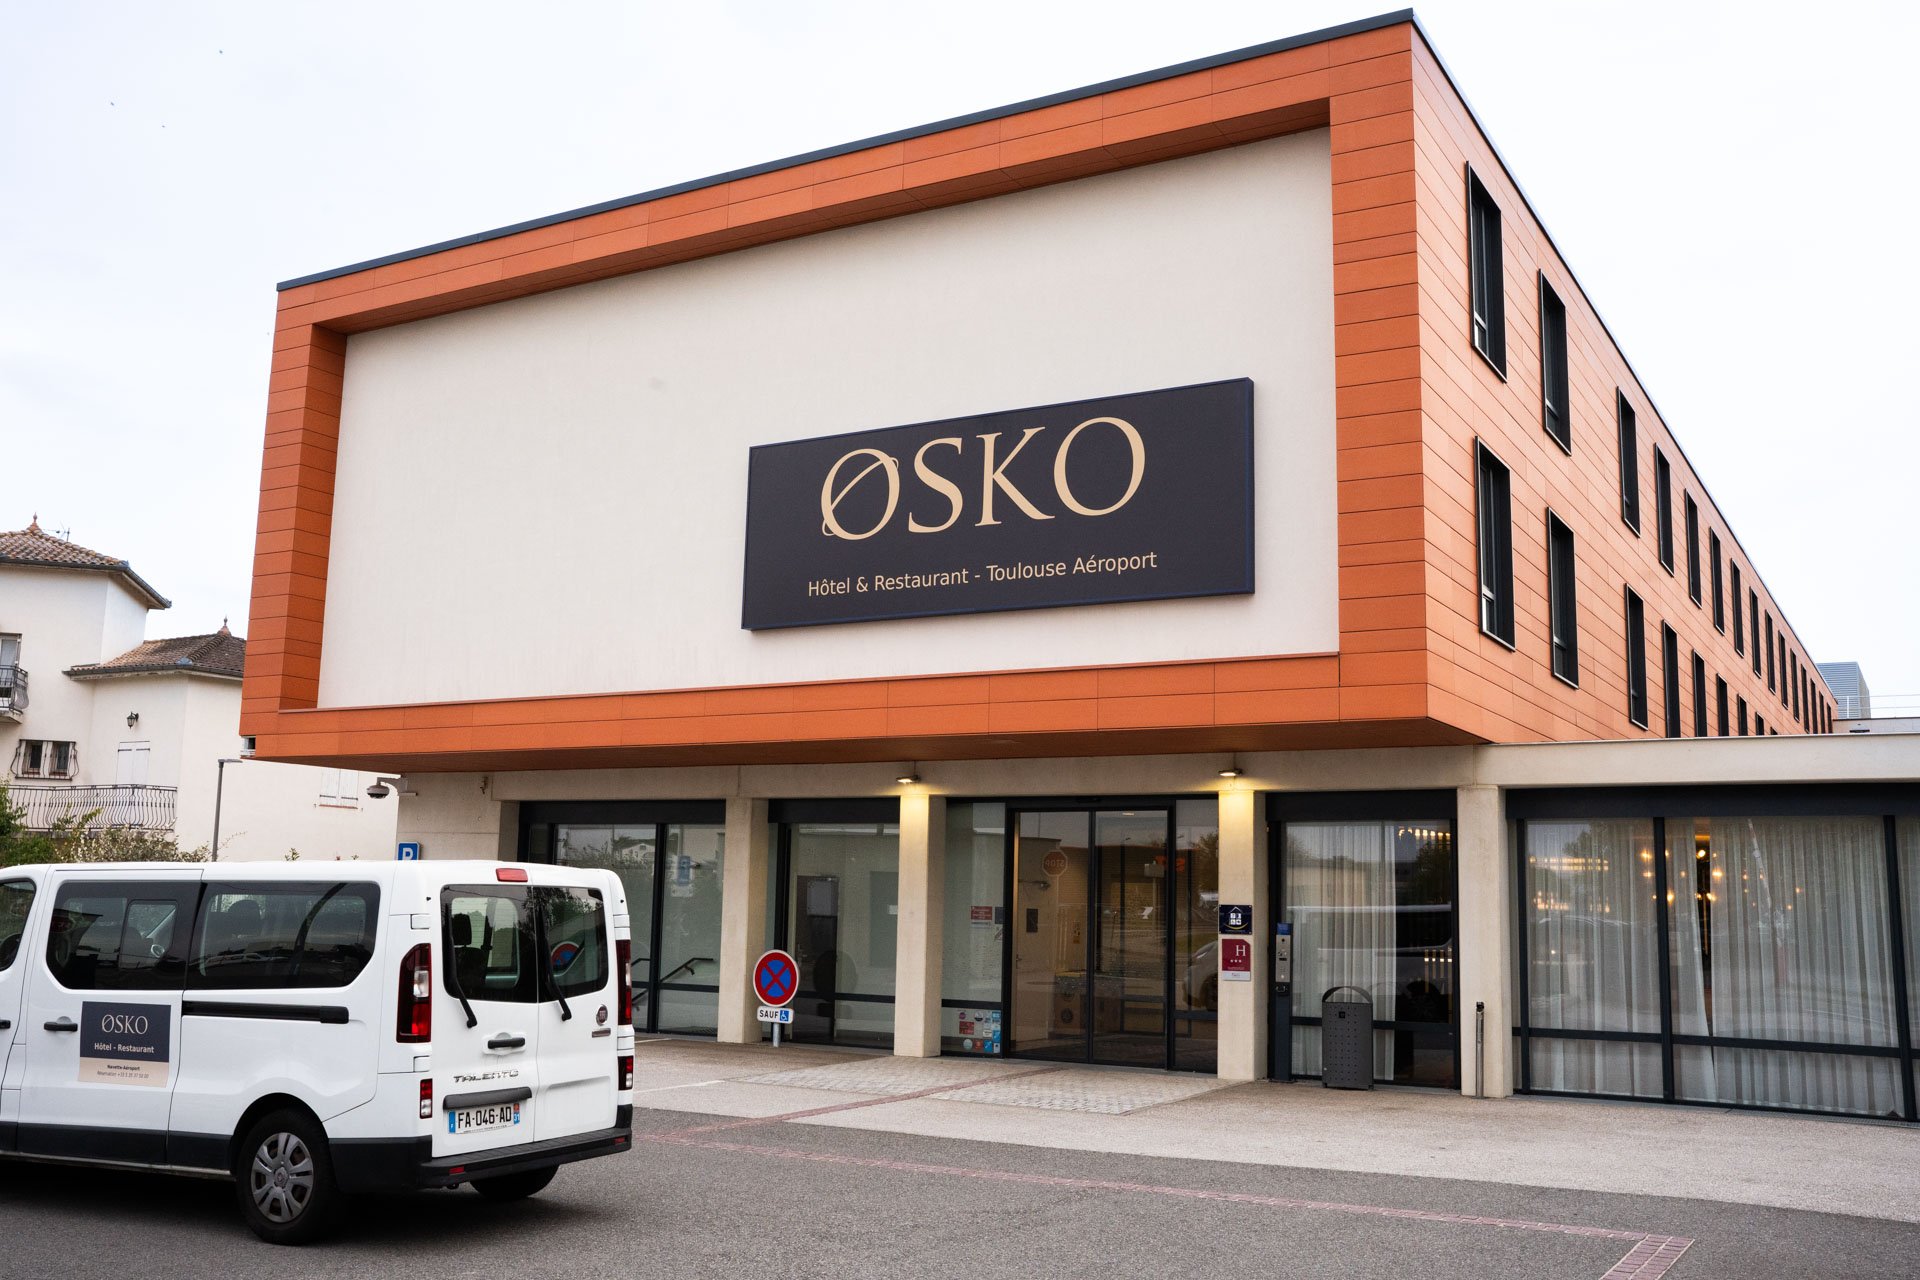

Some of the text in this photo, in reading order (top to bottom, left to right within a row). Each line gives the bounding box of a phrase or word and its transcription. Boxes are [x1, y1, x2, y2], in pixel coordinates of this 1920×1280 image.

[808, 577, 850, 597] Hôtel
[856, 576, 869, 593] &
[874, 568, 969, 591] Restaurant
[986, 562, 1067, 582] Toulouse
[1072, 551, 1157, 575] Aéroport
[402, 847, 414, 860] P
[1235, 944, 1247, 957] H
[759, 1009, 779, 1019] SAUF
[94, 1042, 112, 1051] Hôtel
[117, 1043, 155, 1054] Restaurant
[453, 1069, 519, 1083] TALENTO
[457, 1106, 512, 1129] FA-046-AD
